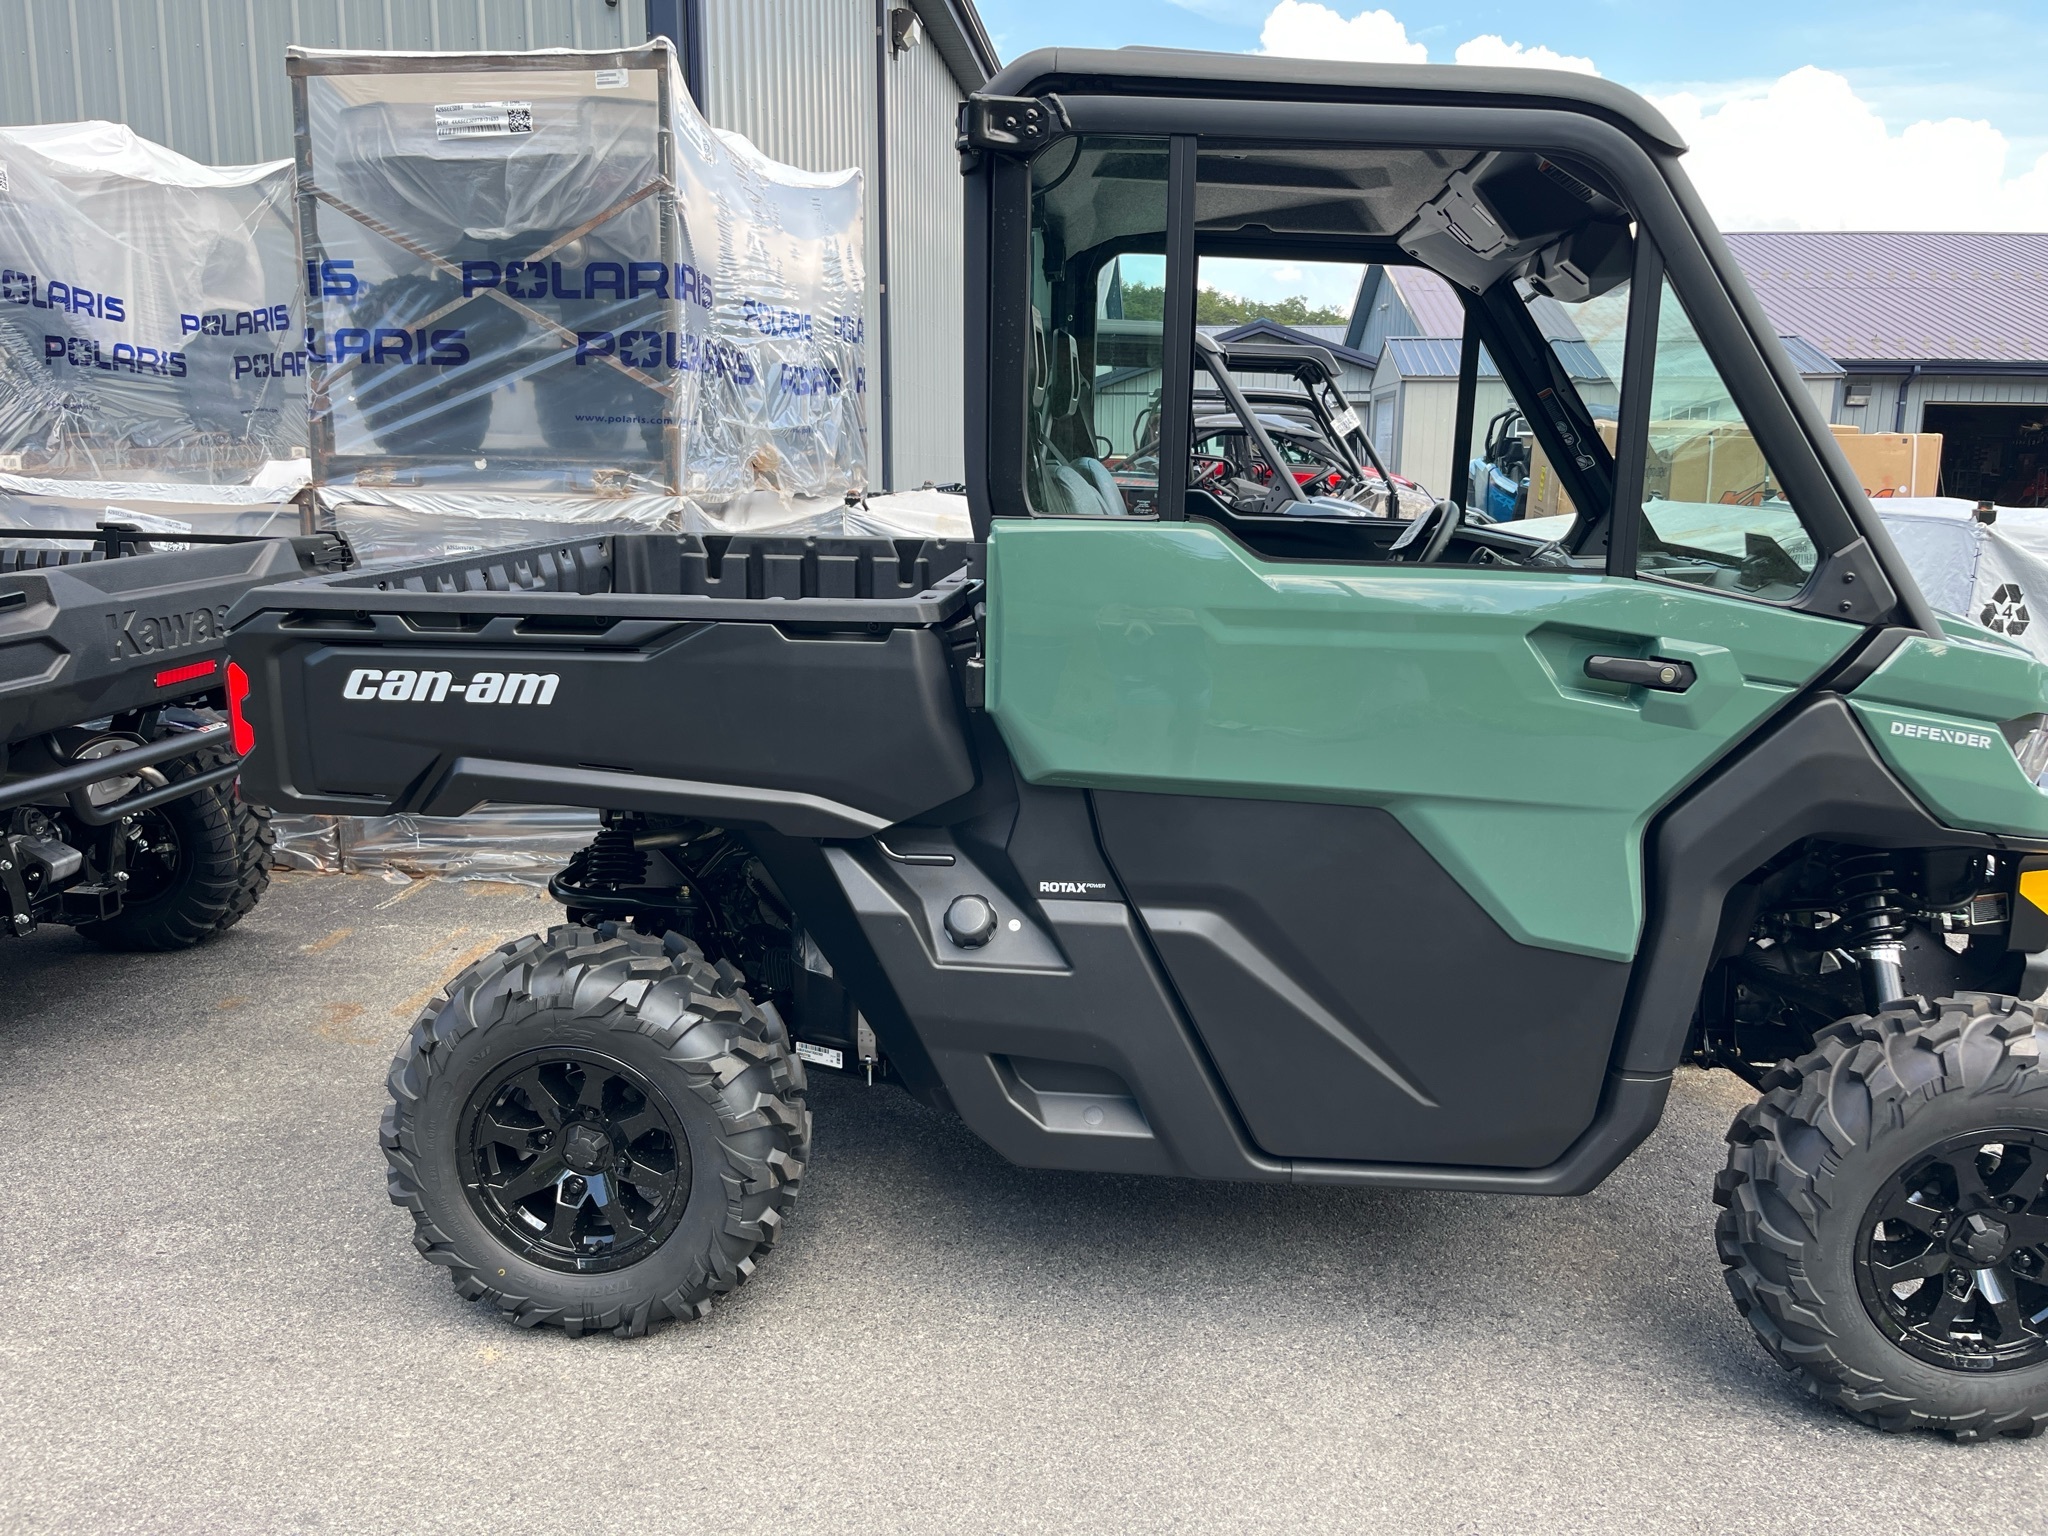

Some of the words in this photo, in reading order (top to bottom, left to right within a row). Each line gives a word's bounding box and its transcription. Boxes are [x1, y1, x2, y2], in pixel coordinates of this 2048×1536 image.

[181, 305, 290, 336] POLARIS
[44, 334, 188, 378] POLARIS
[575, 414, 673, 425] www.polaris.com
[343, 669, 560, 705] can-am
[1890, 721, 1992, 749] DEFENDER
[1040, 881, 1087, 894] ROTAX
